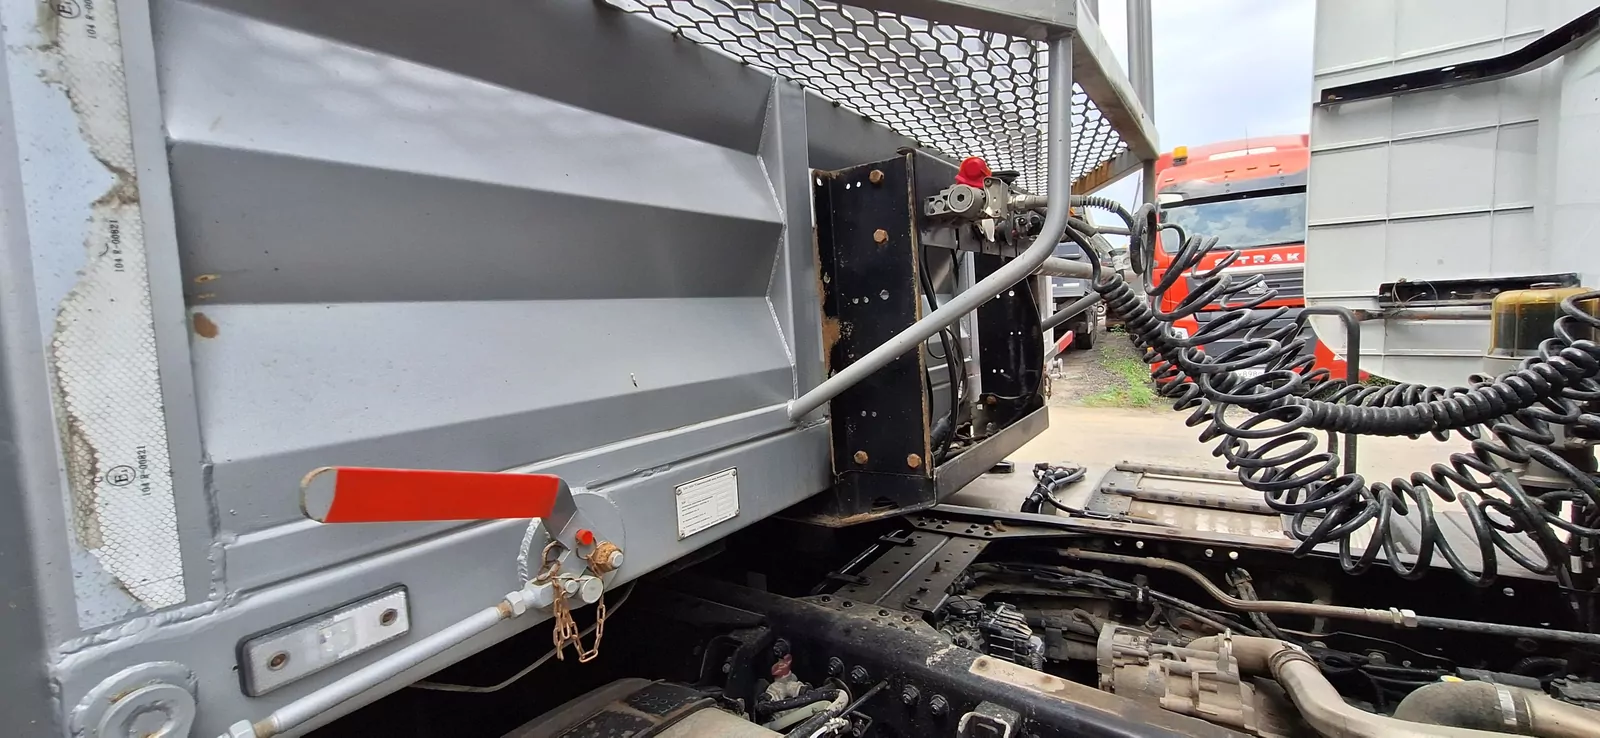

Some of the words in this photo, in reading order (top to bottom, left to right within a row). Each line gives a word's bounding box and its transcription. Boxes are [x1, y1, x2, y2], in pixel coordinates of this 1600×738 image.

[86, 24, 97, 39] 104
[109, 219, 121, 254] R-00821
[114, 258, 125, 272] 104
[1214, 253, 1300, 266] STRAK
[136, 445, 150, 479] R-00821
[141, 482, 151, 496] 104
